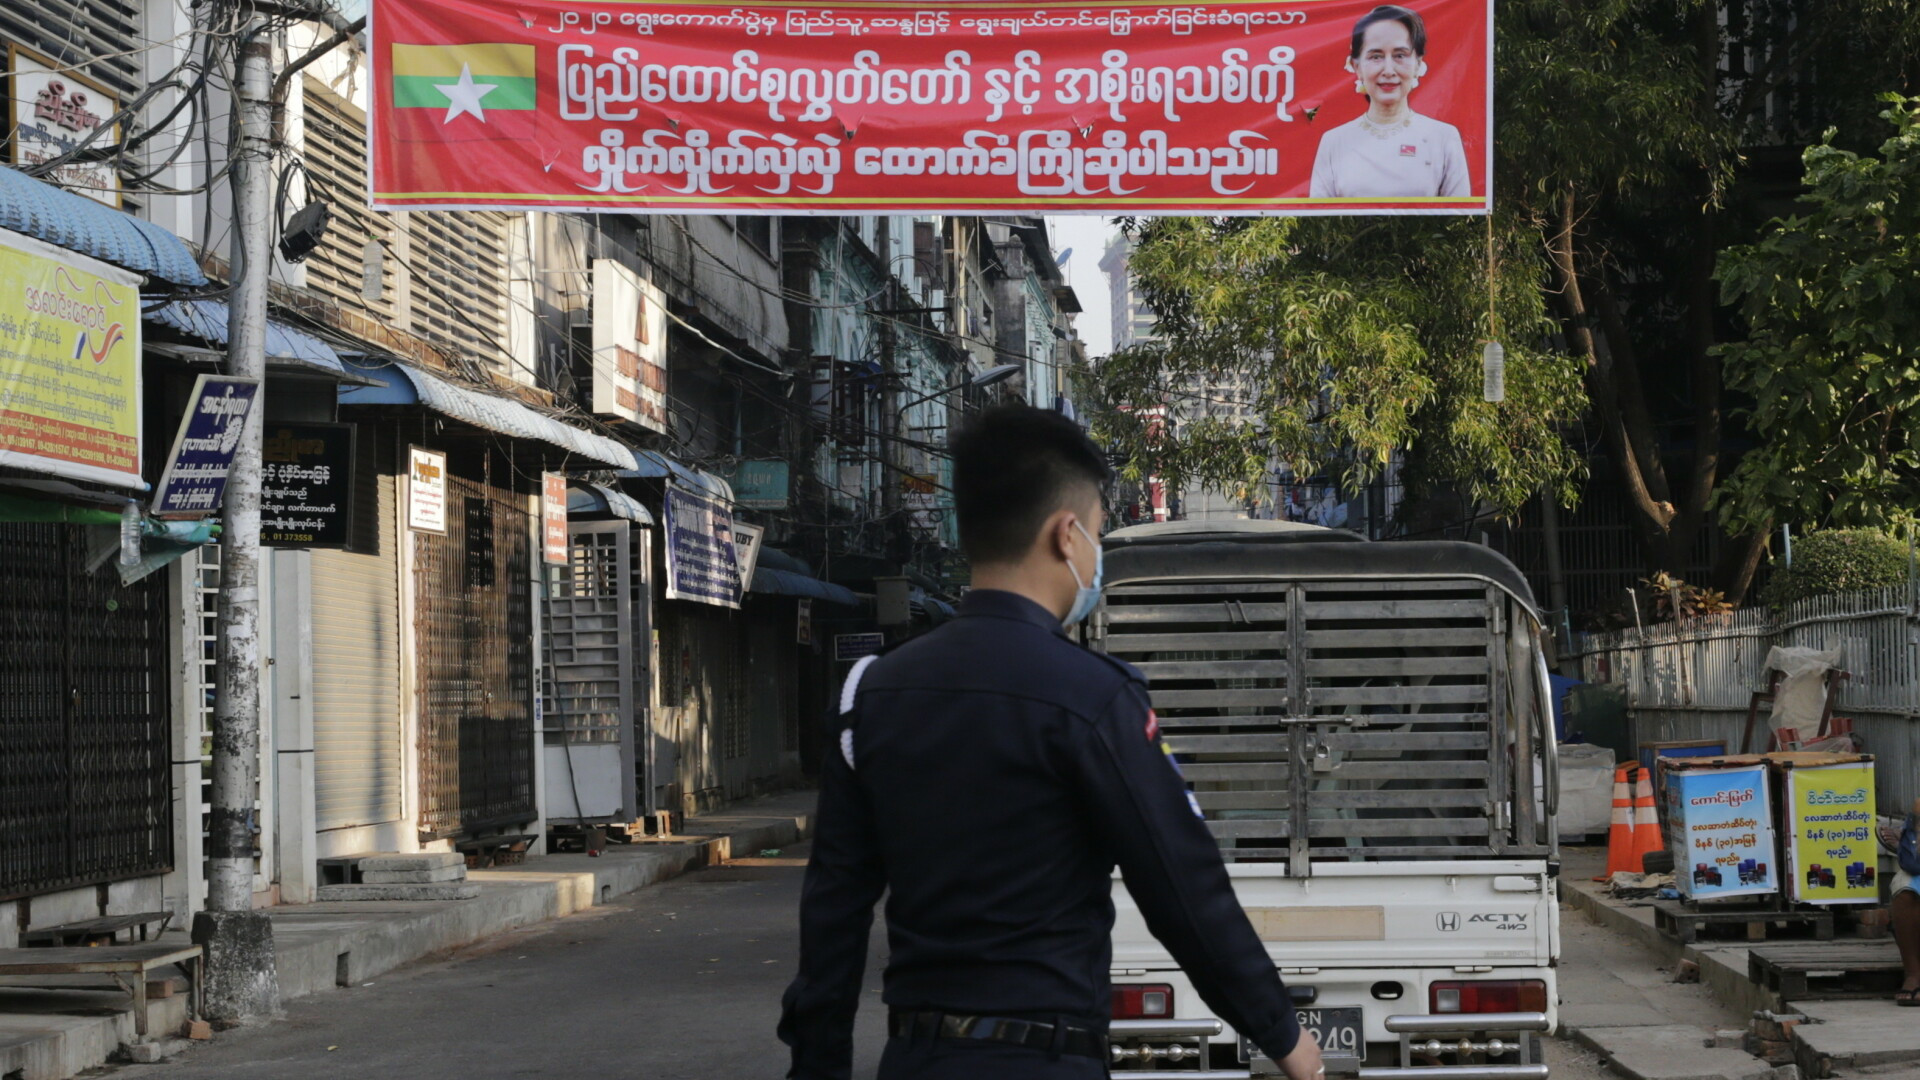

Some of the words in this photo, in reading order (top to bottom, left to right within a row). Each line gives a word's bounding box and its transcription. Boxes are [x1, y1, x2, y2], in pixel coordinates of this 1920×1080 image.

[548, 11, 612, 34] ၂၀၂၀
[984, 49, 1041, 123] နှင့်
[1055, 45, 1296, 123] အစိုးရသစ်ကို
[735, 532, 754, 546] UBY
[1467, 913, 1528, 922] ACTY
[1496, 923, 1527, 931] 4WD
[1296, 1010, 1322, 1025] GN
